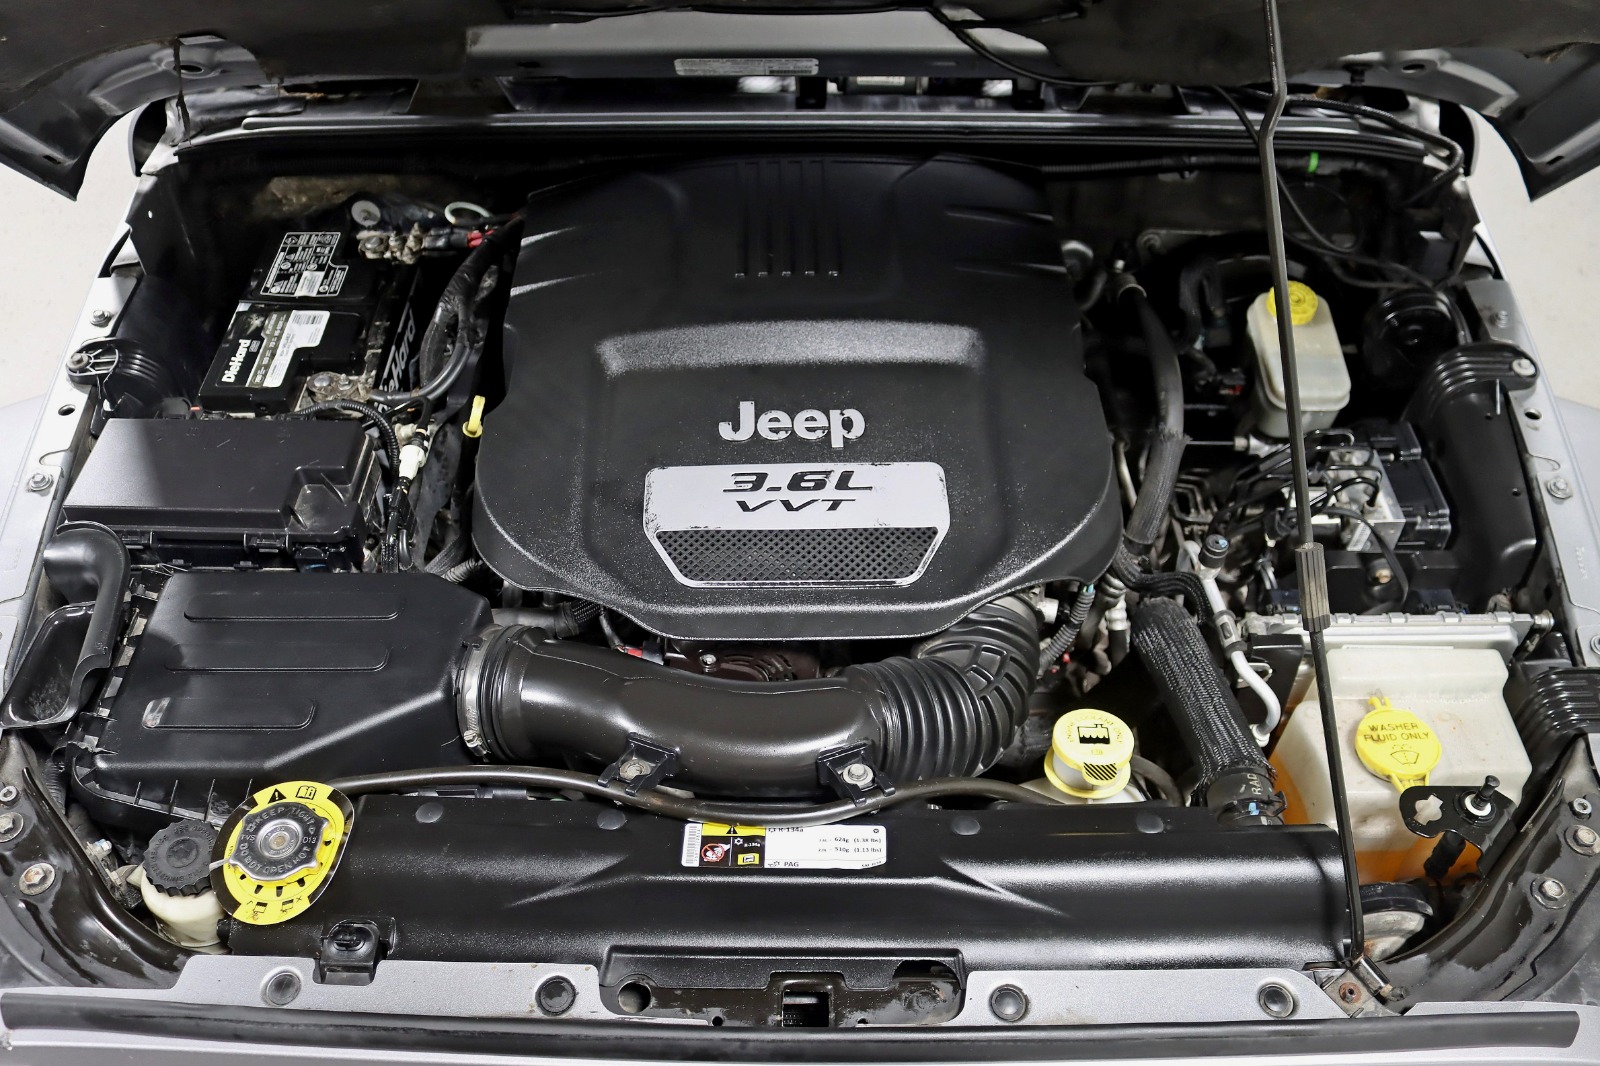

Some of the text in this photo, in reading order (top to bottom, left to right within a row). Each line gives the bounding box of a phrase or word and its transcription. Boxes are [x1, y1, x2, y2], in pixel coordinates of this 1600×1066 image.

[221, 339, 252, 382] DieHard
[718, 400, 866, 450] Jeep
[723, 470, 873, 492] 3.6L
[736, 499, 856, 512] VVT
[1363, 732, 1430, 743] FLUID ONLY
[1368, 722, 1419, 732] WASHER
[1247, 772, 1264, 796] RAD
[255, 805, 316, 827] KEEP TIGHT
[263, 860, 294, 874] OPEN
[293, 845, 312, 865] HOT
